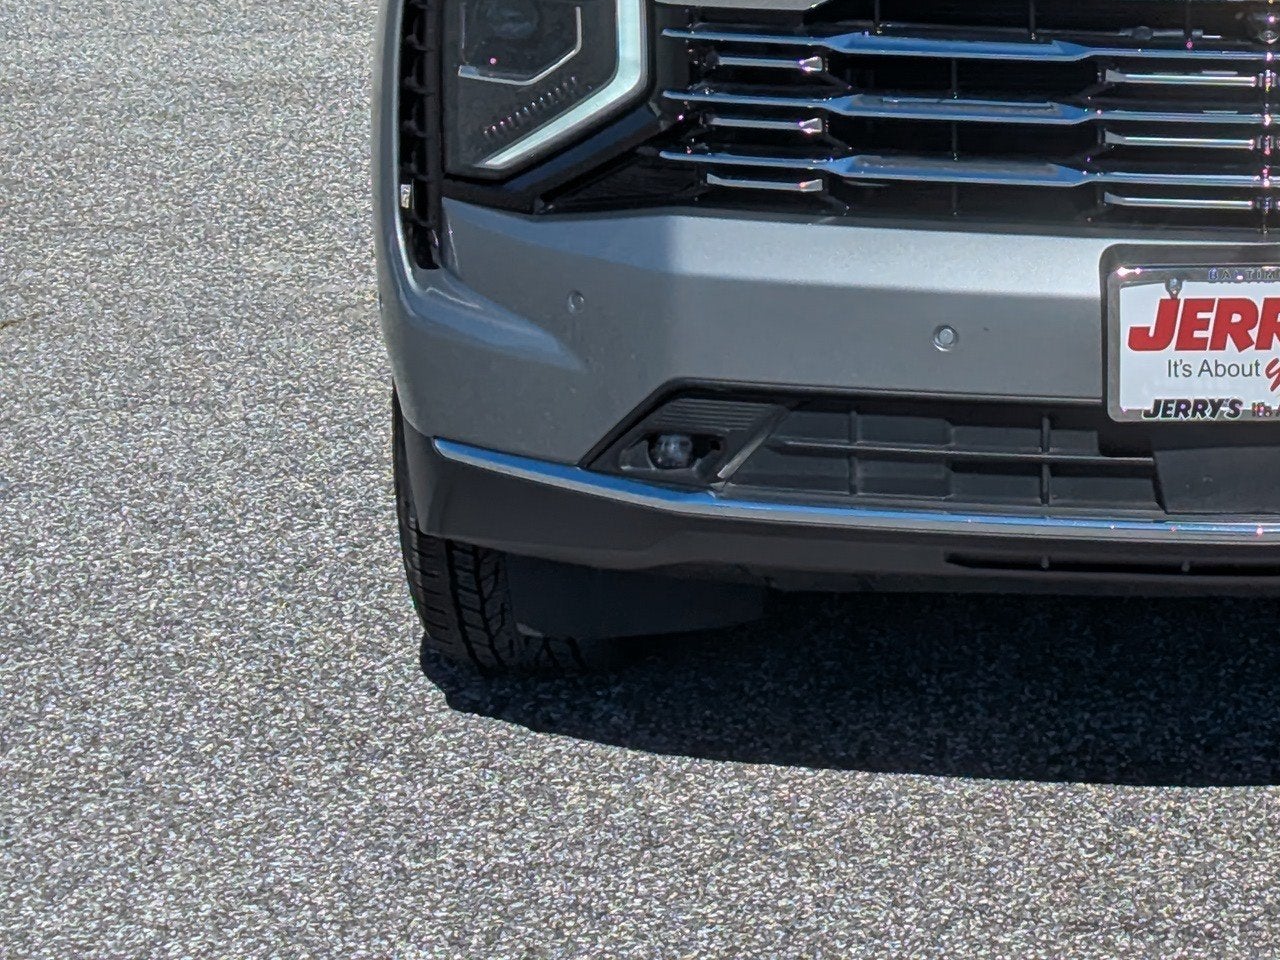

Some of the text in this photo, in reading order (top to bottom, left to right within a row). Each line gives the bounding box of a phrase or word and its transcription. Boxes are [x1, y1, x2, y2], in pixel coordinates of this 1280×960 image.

[1167, 359, 1193, 378] It's
[1197, 359, 1261, 378] About
[1143, 398, 1243, 419] JERRY'S
